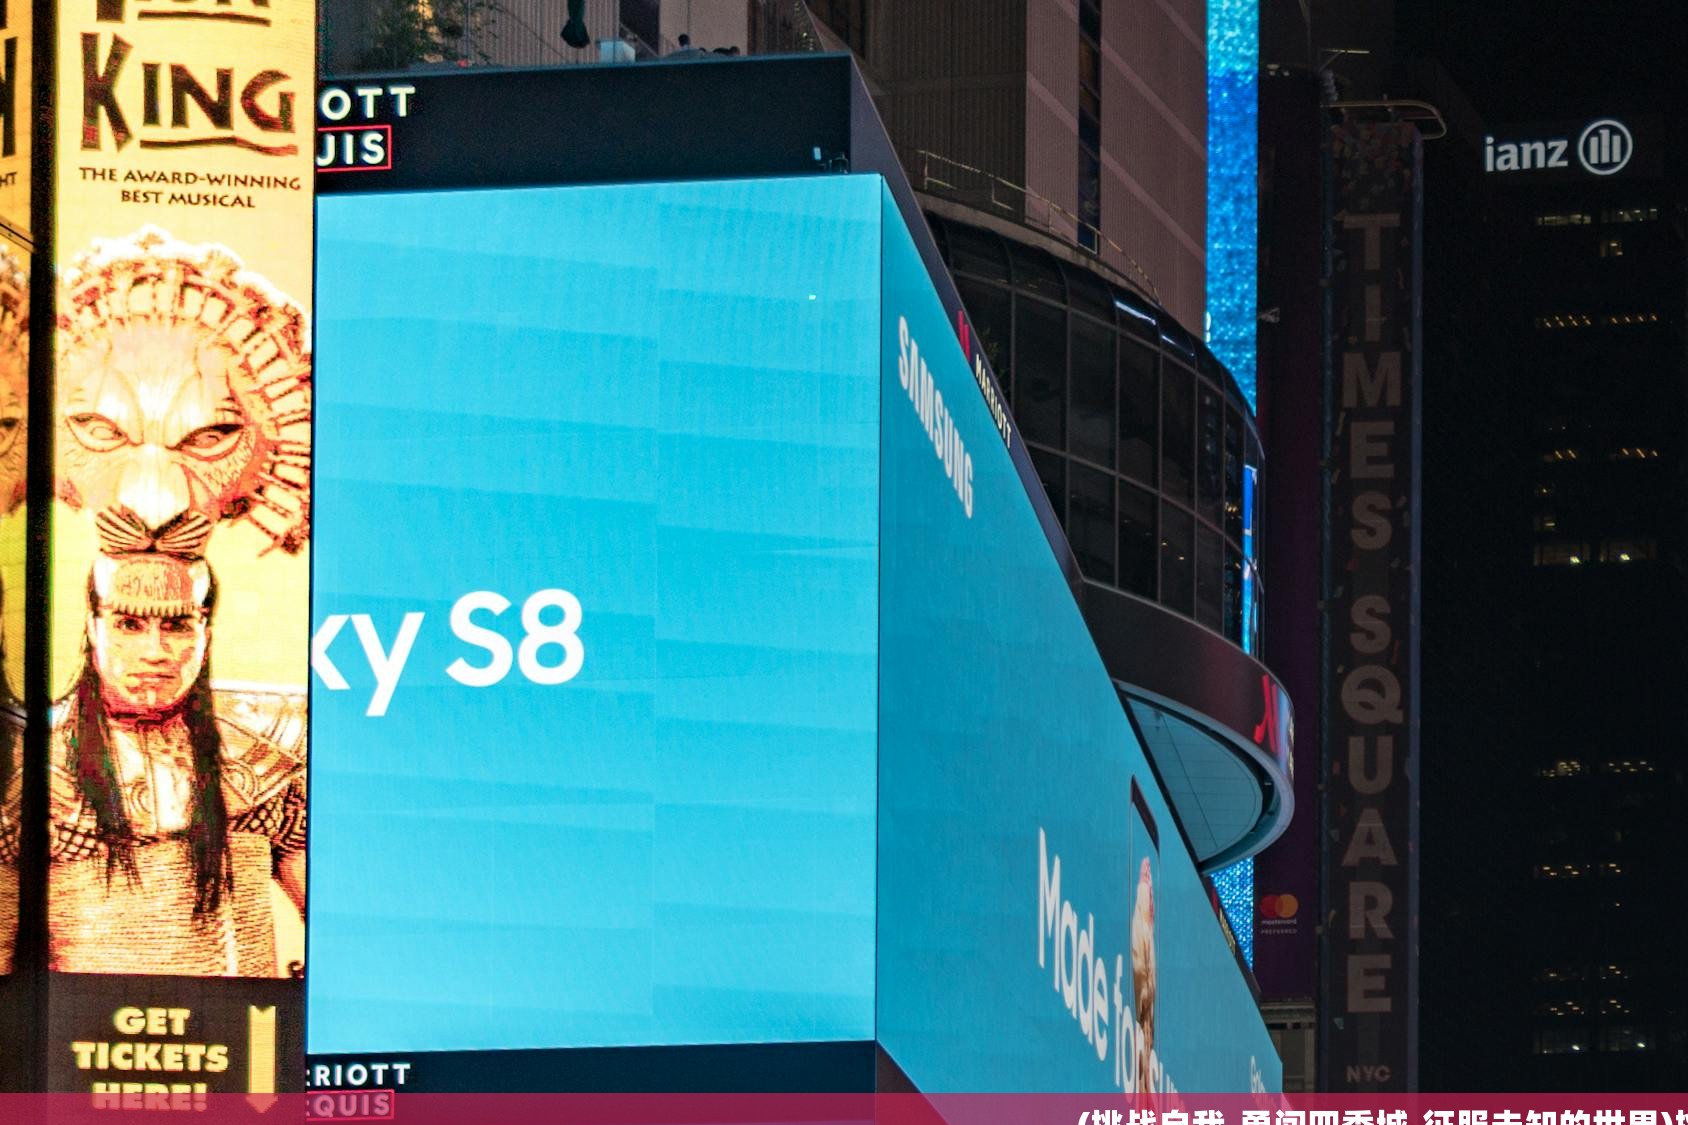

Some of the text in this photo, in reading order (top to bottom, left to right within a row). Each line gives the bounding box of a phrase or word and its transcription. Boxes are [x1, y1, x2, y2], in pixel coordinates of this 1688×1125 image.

[81, 32, 296, 153] KING
[1484, 135, 1569, 173] ianz
[79, 166, 301, 191] THE AWARD-WINNING
[121, 190, 256, 209] BEST MUSICAL
[898, 316, 974, 520] SAMSUNG
[975, 353, 1012, 449] MARRIOTT
[1340, 213, 1404, 1013] TIMES SQUARE
[445, 588, 586, 688] S8
[1038, 827, 1109, 1062] Made
[113, 1007, 192, 1035] GET
[71, 1040, 229, 1071] TICKETS
[1345, 1064, 1392, 1083] NYC
[91, 1082, 209, 1114] HERE!
